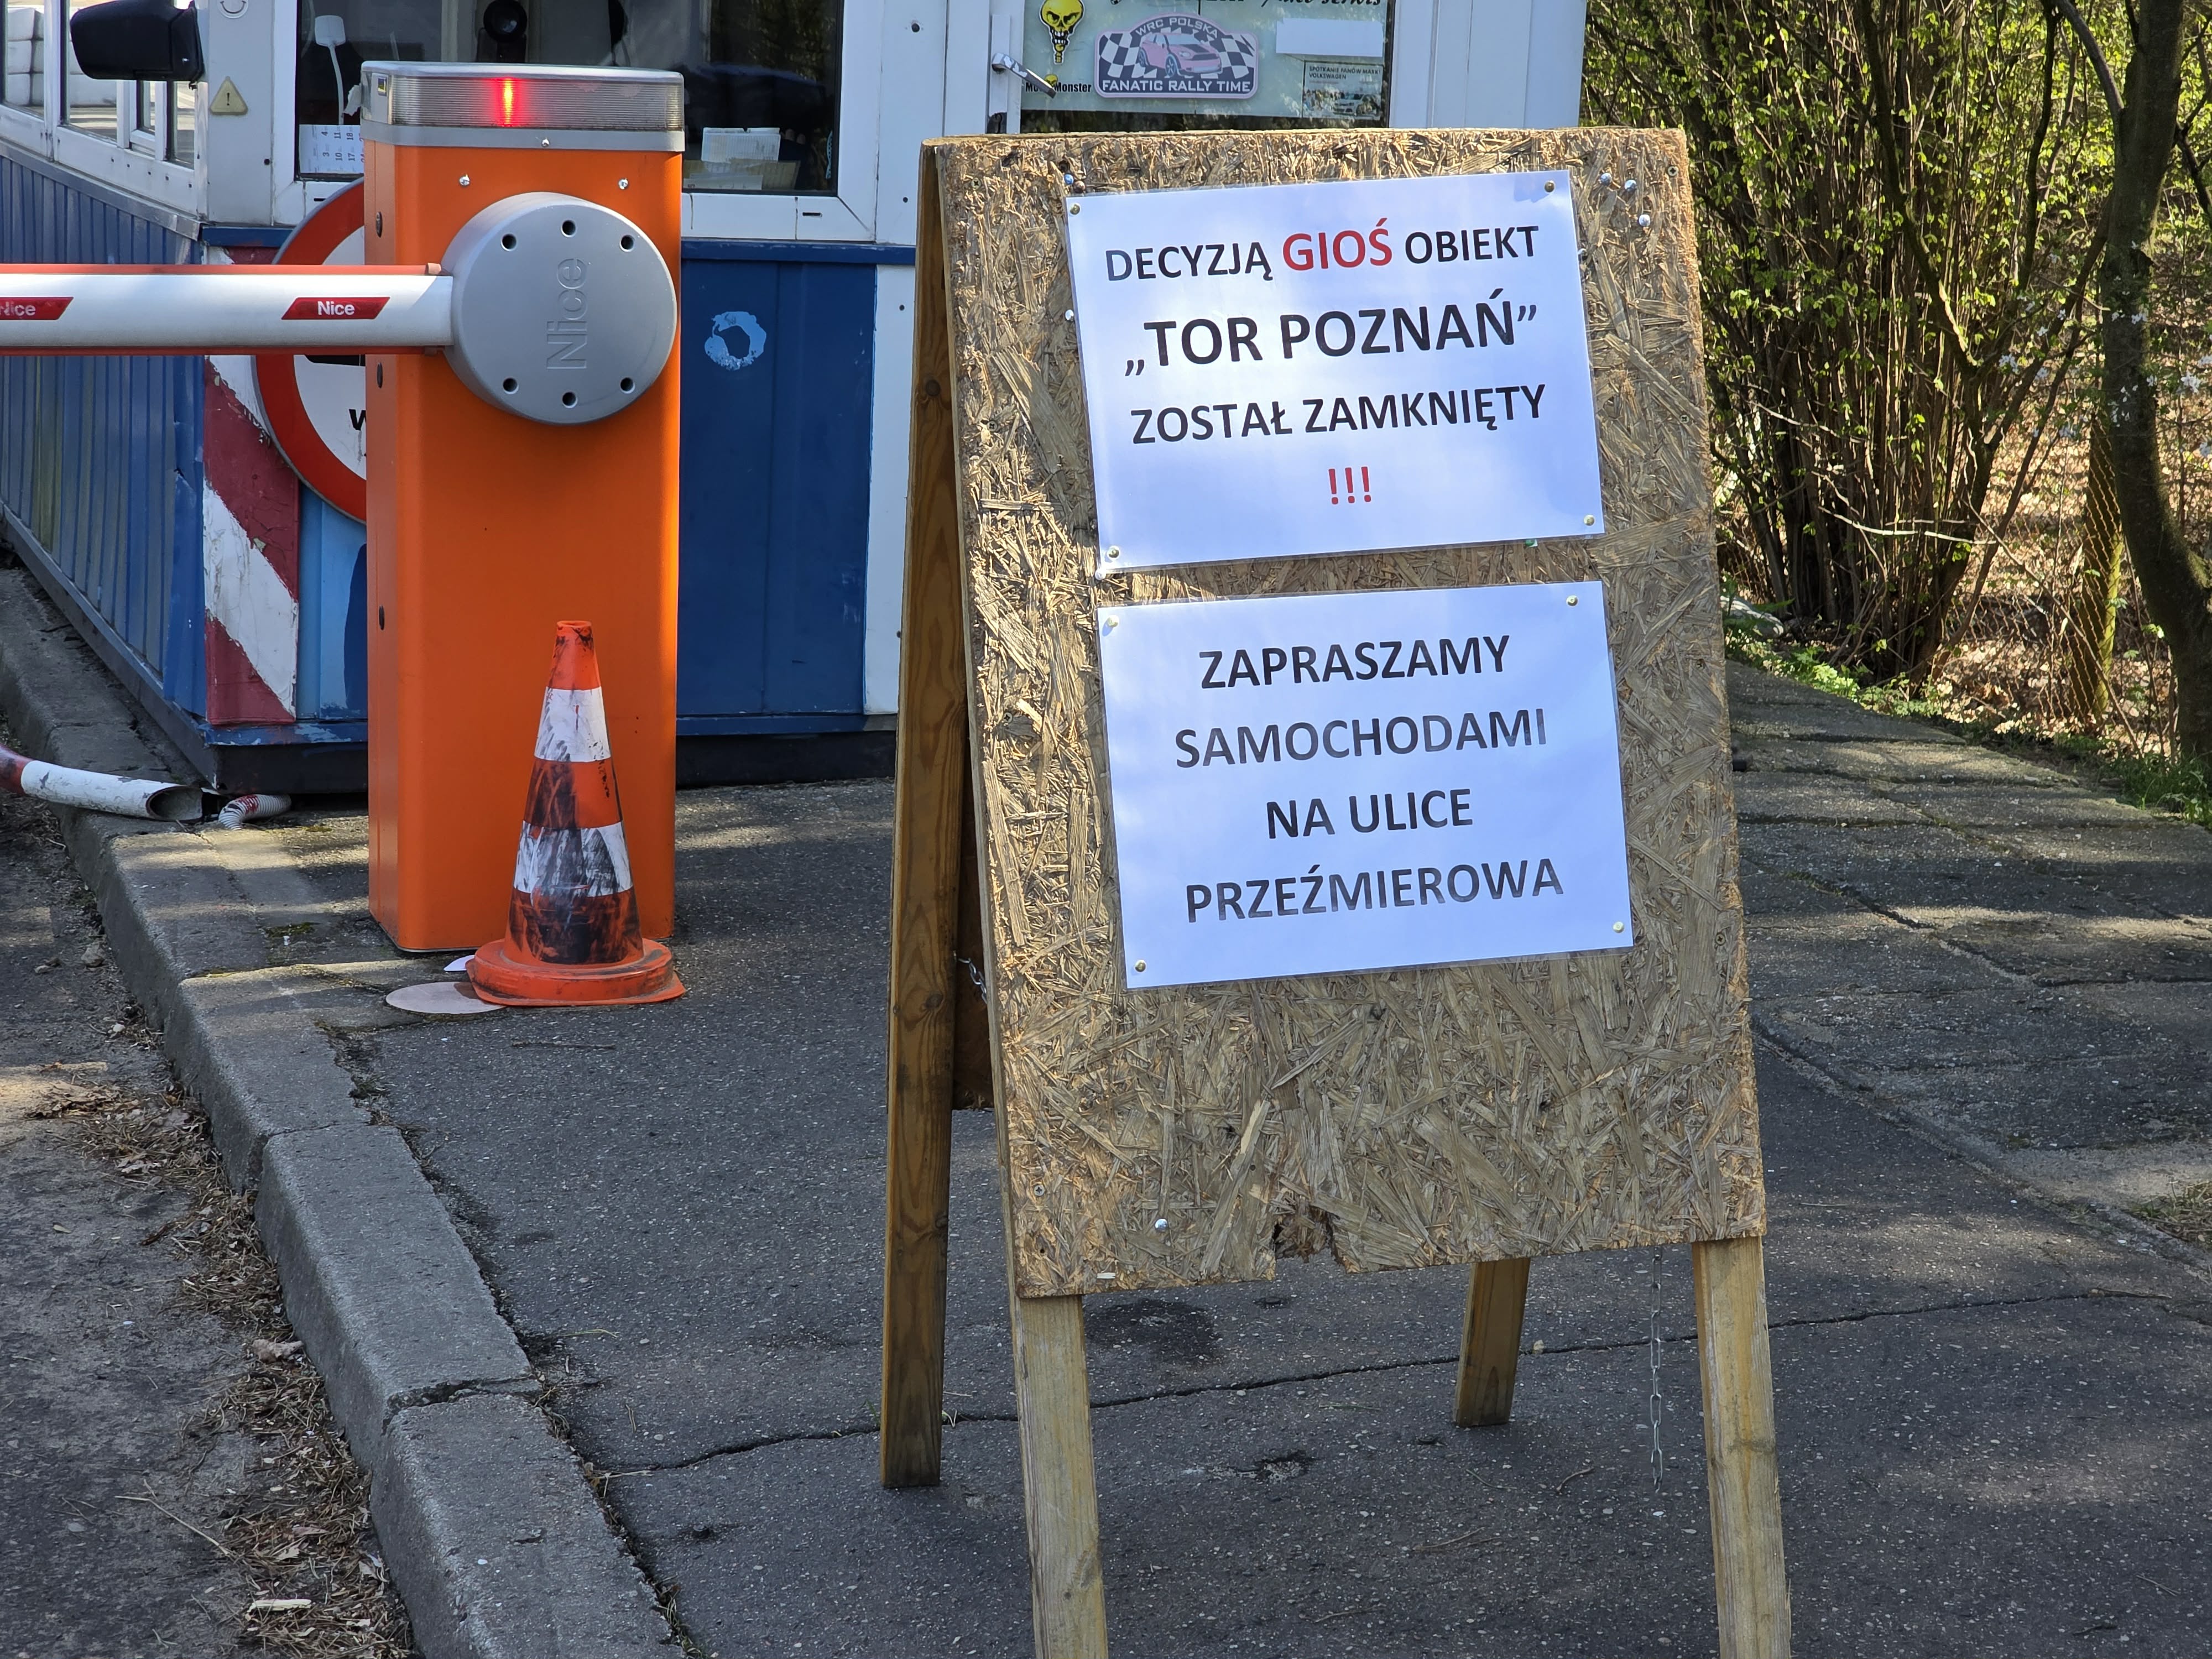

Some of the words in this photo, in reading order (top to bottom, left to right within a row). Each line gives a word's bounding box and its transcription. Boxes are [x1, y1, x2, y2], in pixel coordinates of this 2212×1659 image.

[1135, 19, 1164, 36] WRC
[1169, 18, 1217, 38] POLSKA
[1102, 80, 1163, 91] FANATIC
[1168, 80, 1212, 91] RALLY
[1217, 81, 1250, 92] TIME
[335, 152, 343, 161] 10
[346, 132, 354, 140] 18
[347, 153, 355, 161] 17
[1106, 242, 1272, 281] DECYZJĄ
[1284, 218, 1391, 270] GIOŚ
[1406, 226, 1538, 264] OBIEKT
[317, 302, 355, 315] Nice
[546, 258, 587, 369] Nice
[1125, 317, 1262, 376] „TOR
[1280, 288, 1536, 358] POZNAŃ”
[1131, 401, 1292, 444] ZOSTAŁ
[1303, 384, 1545, 432] ZAMKNIĘTY
[1329, 466, 1371, 504] !!!
[1199, 635, 1509, 688] ZAPRASZAMY
[1176, 708, 1546, 768] SAMOCHODAMI
[1267, 799, 1335, 839] NA
[1349, 789, 1473, 833] ULICE
[1187, 858, 1563, 922] PRZEŹMIEROWA
